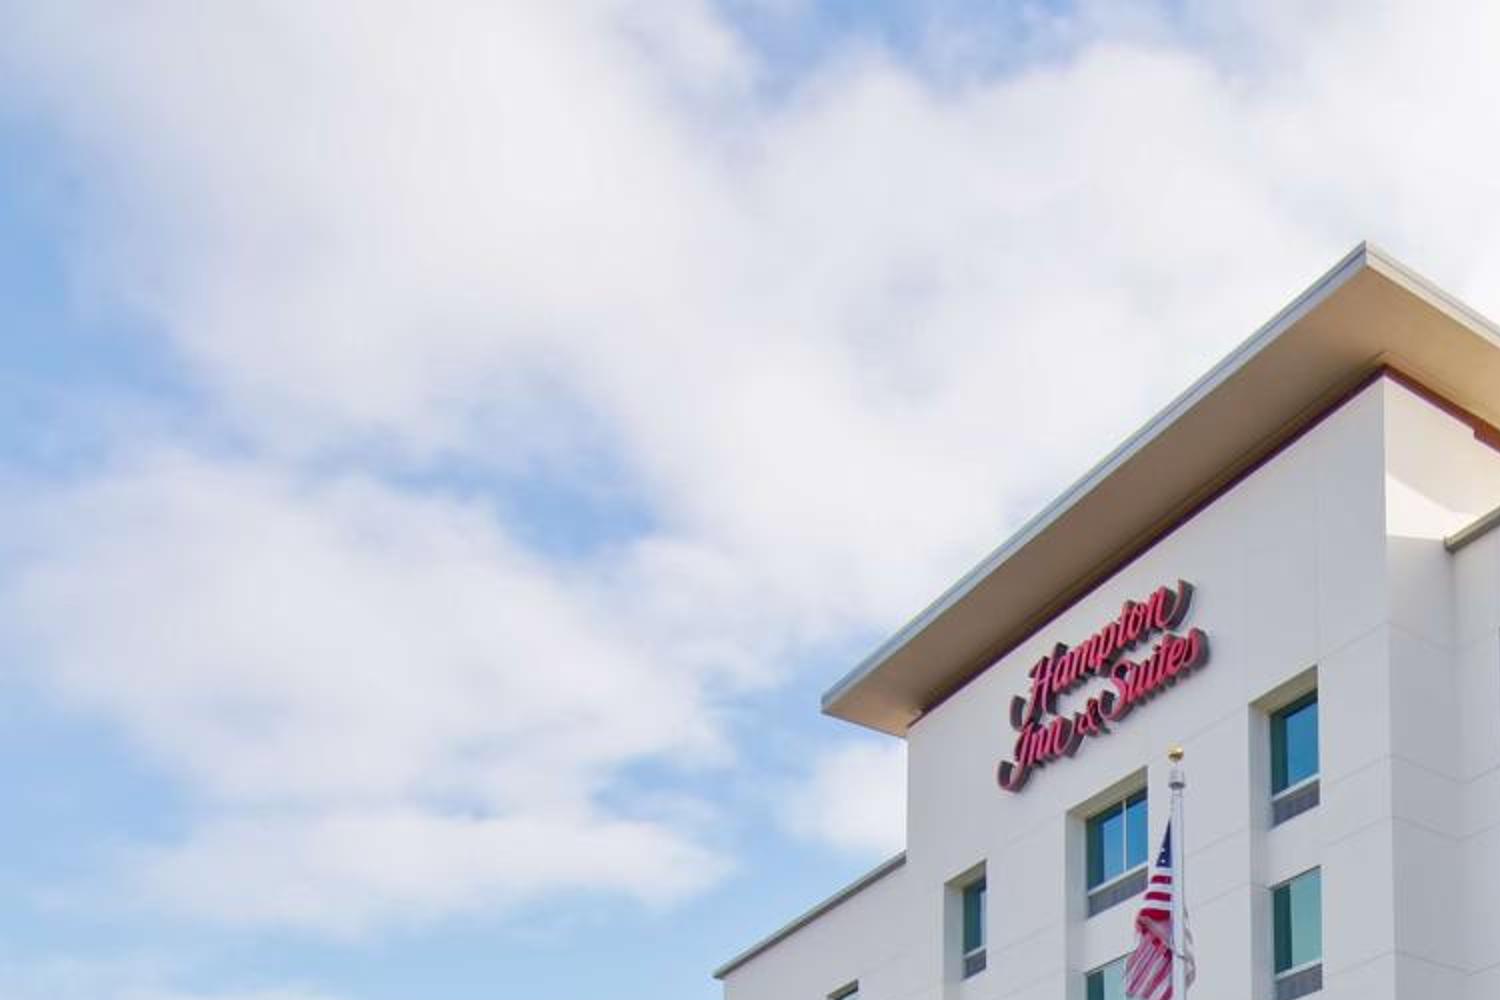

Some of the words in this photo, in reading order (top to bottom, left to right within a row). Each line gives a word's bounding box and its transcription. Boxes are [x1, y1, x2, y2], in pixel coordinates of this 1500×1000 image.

[998, 711, 1083, 793] Inn
[1077, 697, 1111, 737] &
[1099, 627, 1211, 722] Suites
[1010, 579, 1195, 732] Hampton
